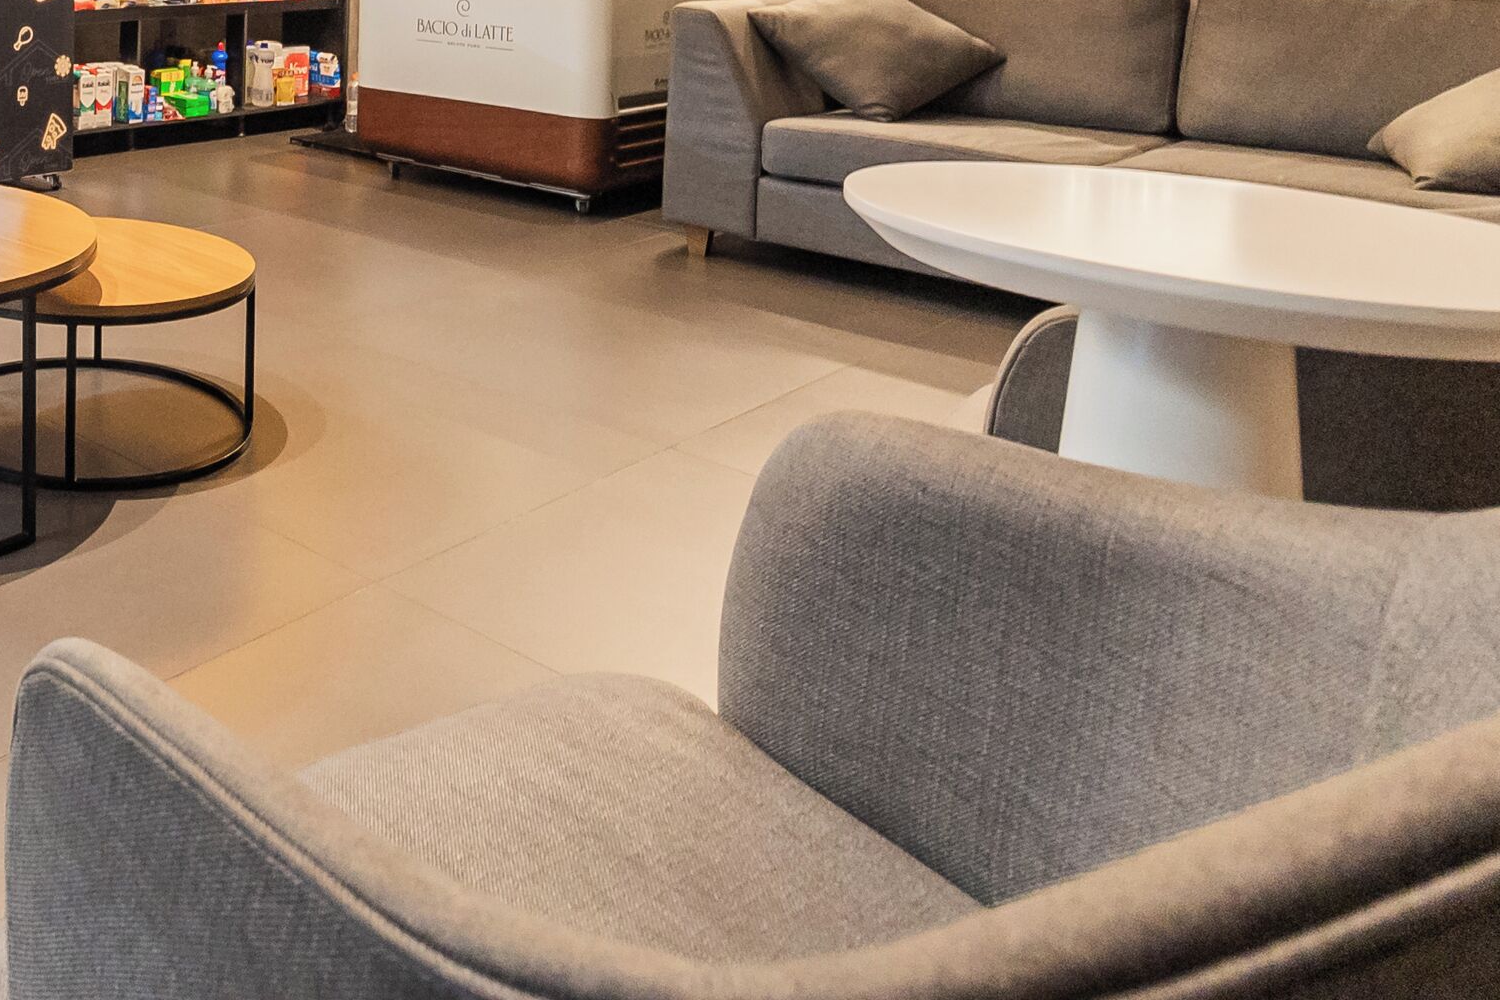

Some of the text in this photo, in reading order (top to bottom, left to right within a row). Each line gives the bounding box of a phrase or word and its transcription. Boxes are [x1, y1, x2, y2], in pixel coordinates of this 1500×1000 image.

[416, 18, 514, 42] BACIO di LATTE
